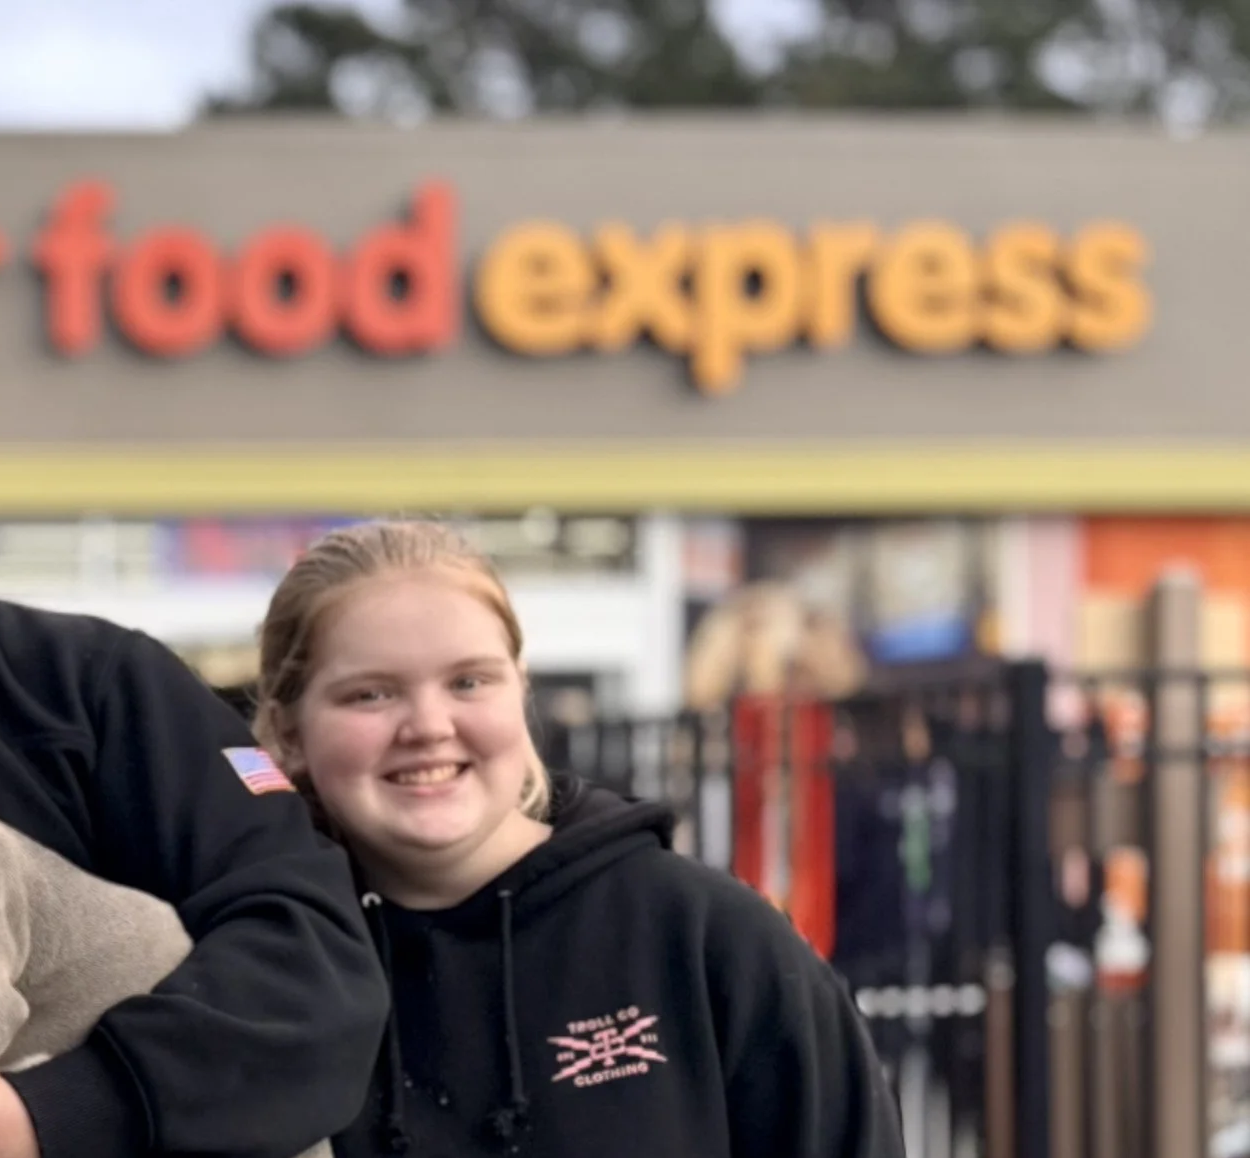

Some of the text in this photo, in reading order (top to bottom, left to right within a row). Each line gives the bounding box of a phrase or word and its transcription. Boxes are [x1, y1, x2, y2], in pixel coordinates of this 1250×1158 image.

[32, 182, 456, 357] food
[475, 219, 1152, 392] express
[567, 1014, 615, 1034] TROLL
[573, 1061, 649, 1088] CLOTHING
